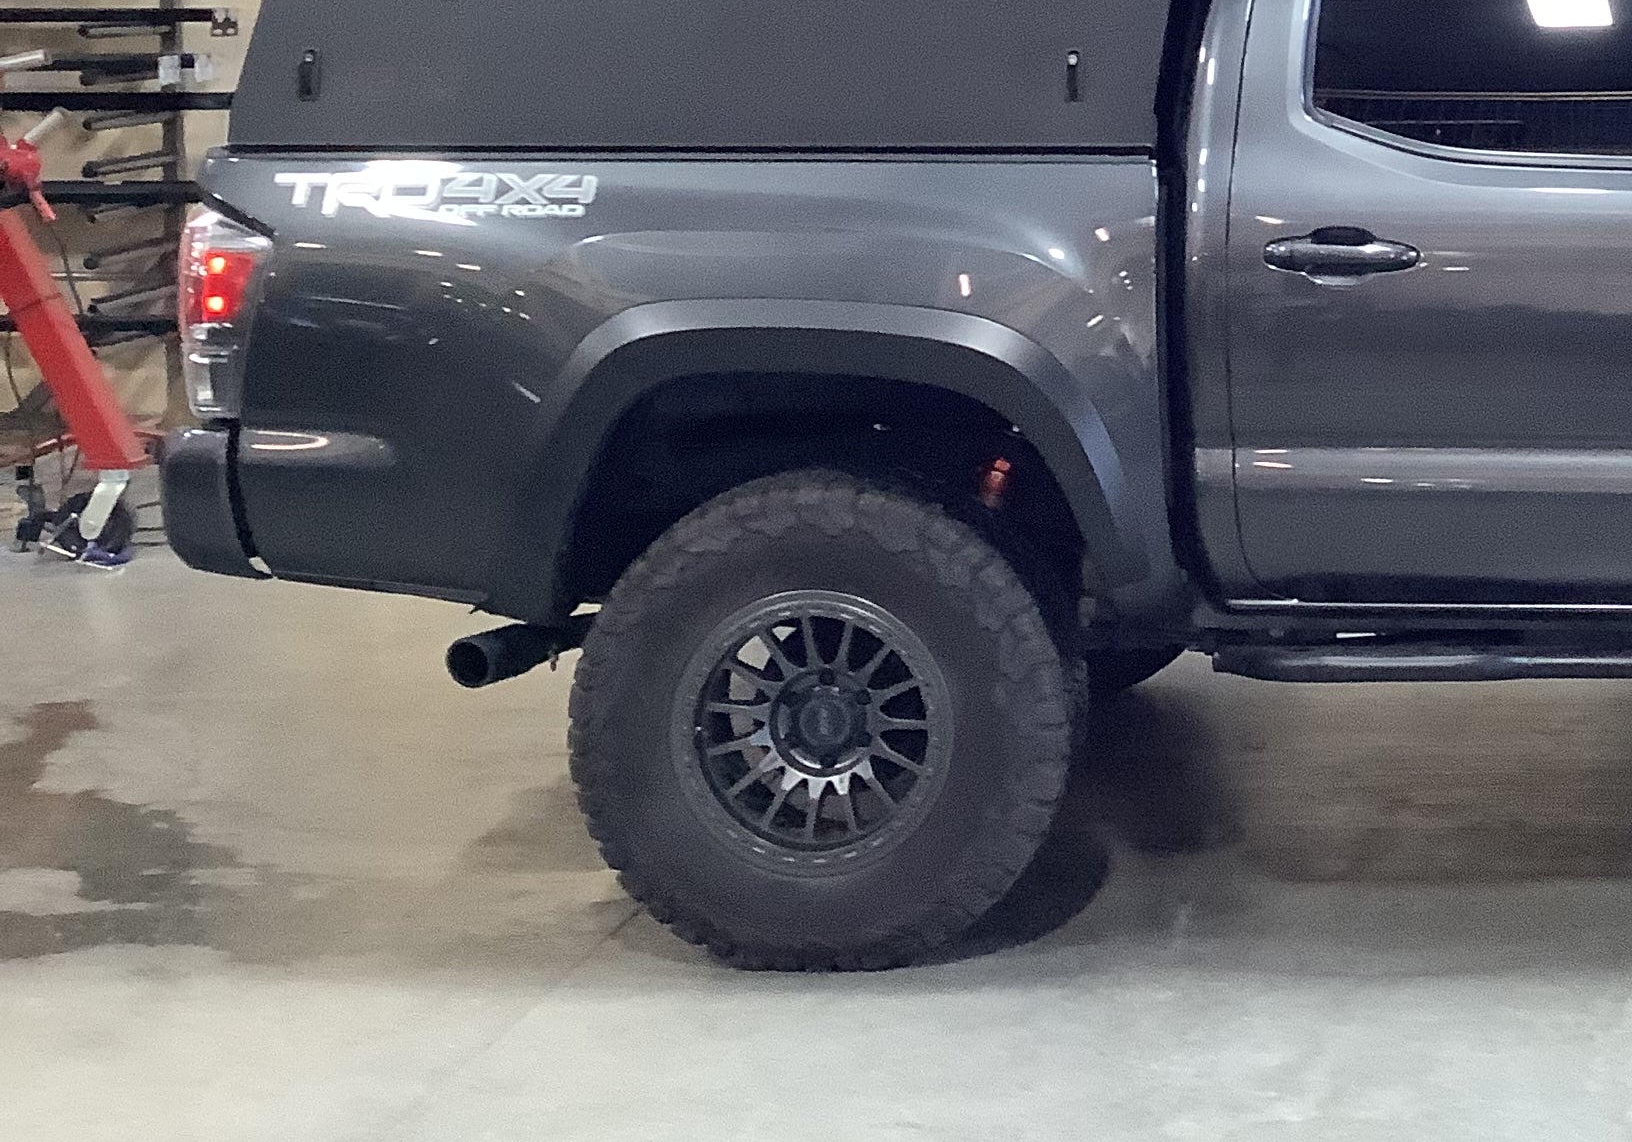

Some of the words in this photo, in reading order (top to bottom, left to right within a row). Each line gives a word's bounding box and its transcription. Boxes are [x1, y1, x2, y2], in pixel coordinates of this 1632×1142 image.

[275, 171, 444, 219] TRD
[440, 204, 496, 218] OFF
[502, 204, 586, 218] ROAD
